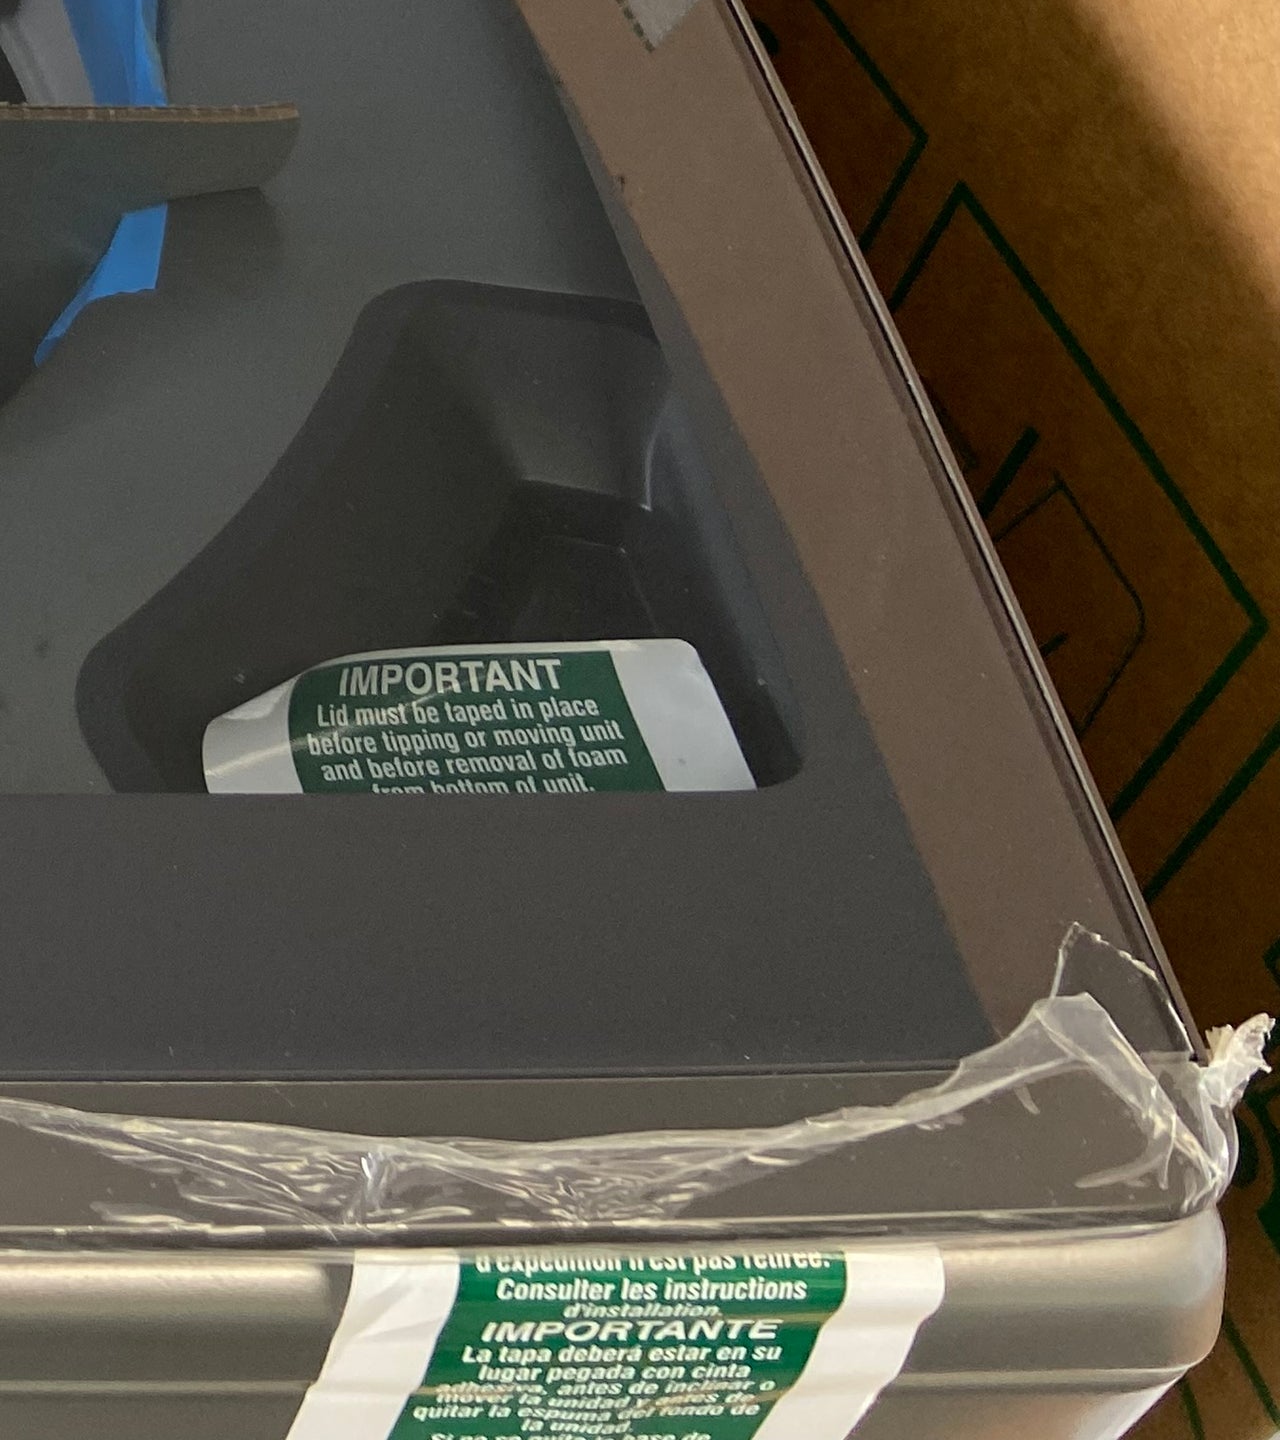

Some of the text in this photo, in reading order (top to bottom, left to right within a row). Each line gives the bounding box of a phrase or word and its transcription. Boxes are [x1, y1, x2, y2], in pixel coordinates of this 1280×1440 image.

[340, 659, 561, 696] IMPORTANT
[317, 696, 599, 729] Lid must be taped in place
[497, 1276, 807, 1300] Consulter les instructions
[481, 1318, 784, 1342] IMPORTANTE
